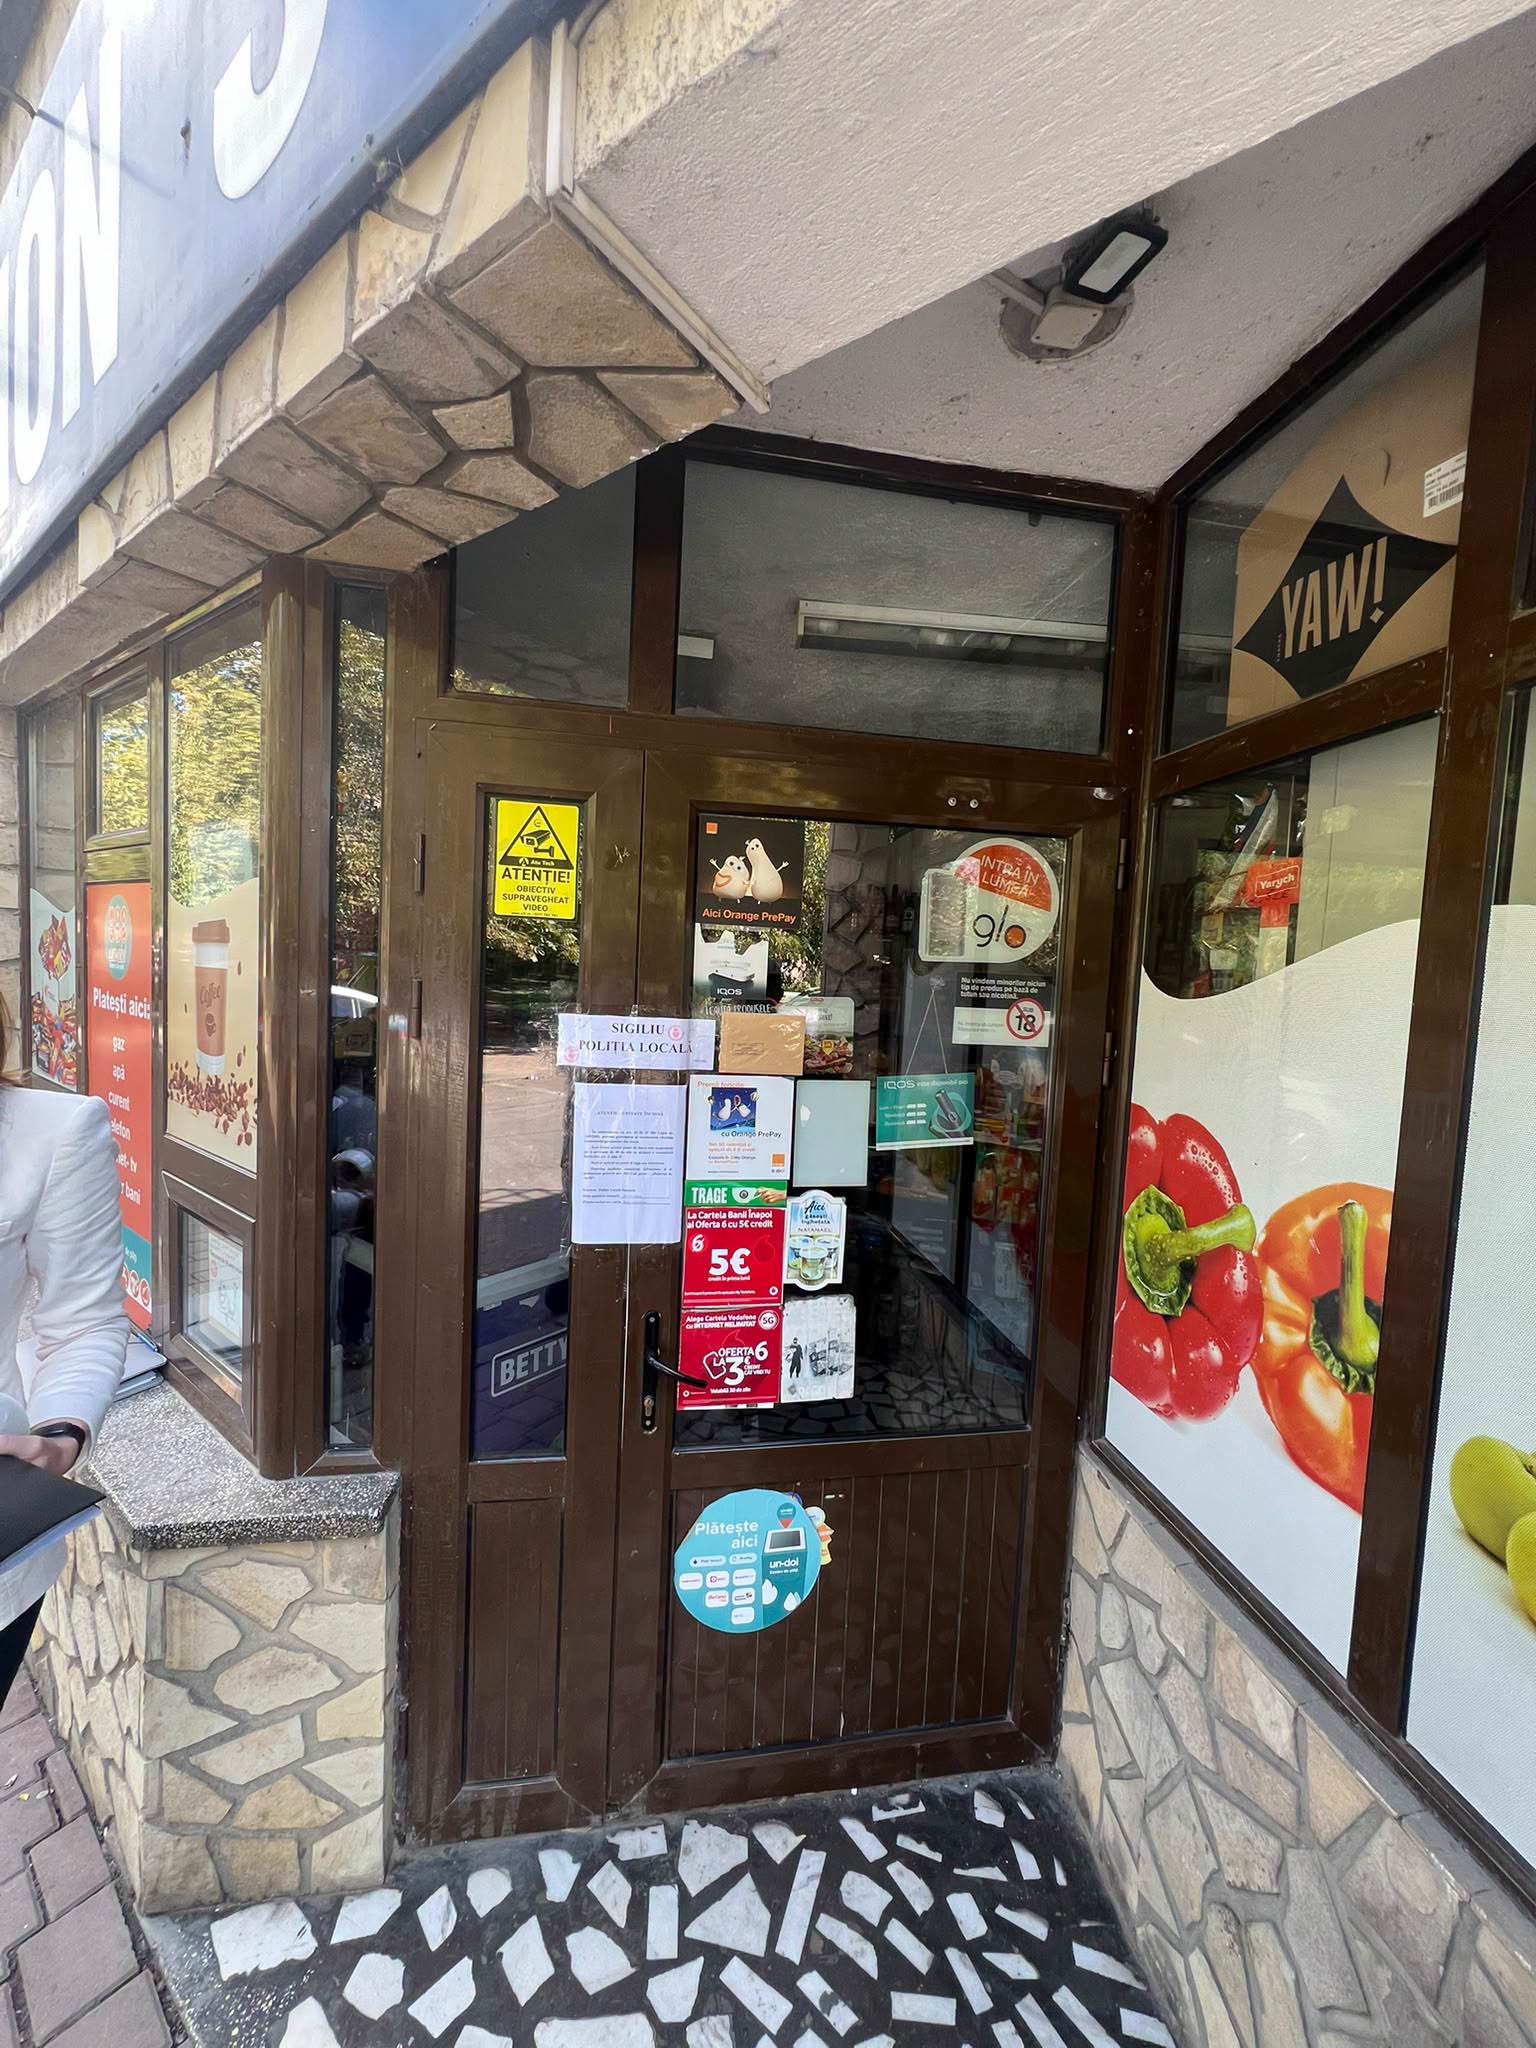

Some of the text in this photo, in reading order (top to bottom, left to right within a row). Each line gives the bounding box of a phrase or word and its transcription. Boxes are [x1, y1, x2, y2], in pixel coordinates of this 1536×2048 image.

[0, 4, 122, 517] ON
[1281, 536, 1388, 658] YAW!
[501, 867, 571, 885] ATENȚIE!
[1258, 873, 1296, 891] Yarych
[516, 884, 556, 894] OBIECTIV
[982, 872, 1029, 897] LUMEA
[502, 893, 569, 904] SUPRAVEGHEAT
[523, 903, 549, 912] VIDEO
[702, 908, 797, 925] Aici Orange PrePay
[717, 987, 743, 996] IQOS
[980, 985, 1003, 993] produs
[611, 1022, 665, 1035] SIGILIU
[1015, 1014, 1036, 1032] 18
[112, 1035, 126, 1053] gaz
[579, 1039, 693, 1054] POLIȚIA LOCALĂ
[883, 1080, 916, 1090] IQOS
[108, 1090, 131, 1112] curent
[110, 1117, 131, 1143] elefon
[731, 1130, 757, 1139] Orange
[757, 1131, 782, 1139] PrePay
[125, 1183, 141, 1206] bani
[691, 1187, 728, 1204] TRAGE
[687, 1211, 697, 1219] La
[698, 1210, 727, 1219] Cartela
[728, 1210, 748, 1219] Banii
[804, 1200, 826, 1215] Aici
[695, 1220, 721, 1228] Oferta
[721, 1220, 728, 1228] 6
[738, 1219, 749, 1228] 5€
[750, 1219, 774, 1228] credit
[708, 1247, 752, 1276] 5€
[686, 1315, 704, 1323] Alege
[728, 1313, 757, 1321] Vodafone
[762, 1316, 775, 1325] 5G
[718, 1340, 769, 1361] OFERTA 6
[713, 1357, 726, 1367] LA
[723, 1356, 745, 1386] 3
[694, 1520, 759, 1536] Plătește
[731, 1534, 759, 1549] aici
[769, 1557, 800, 1568] un-doi
